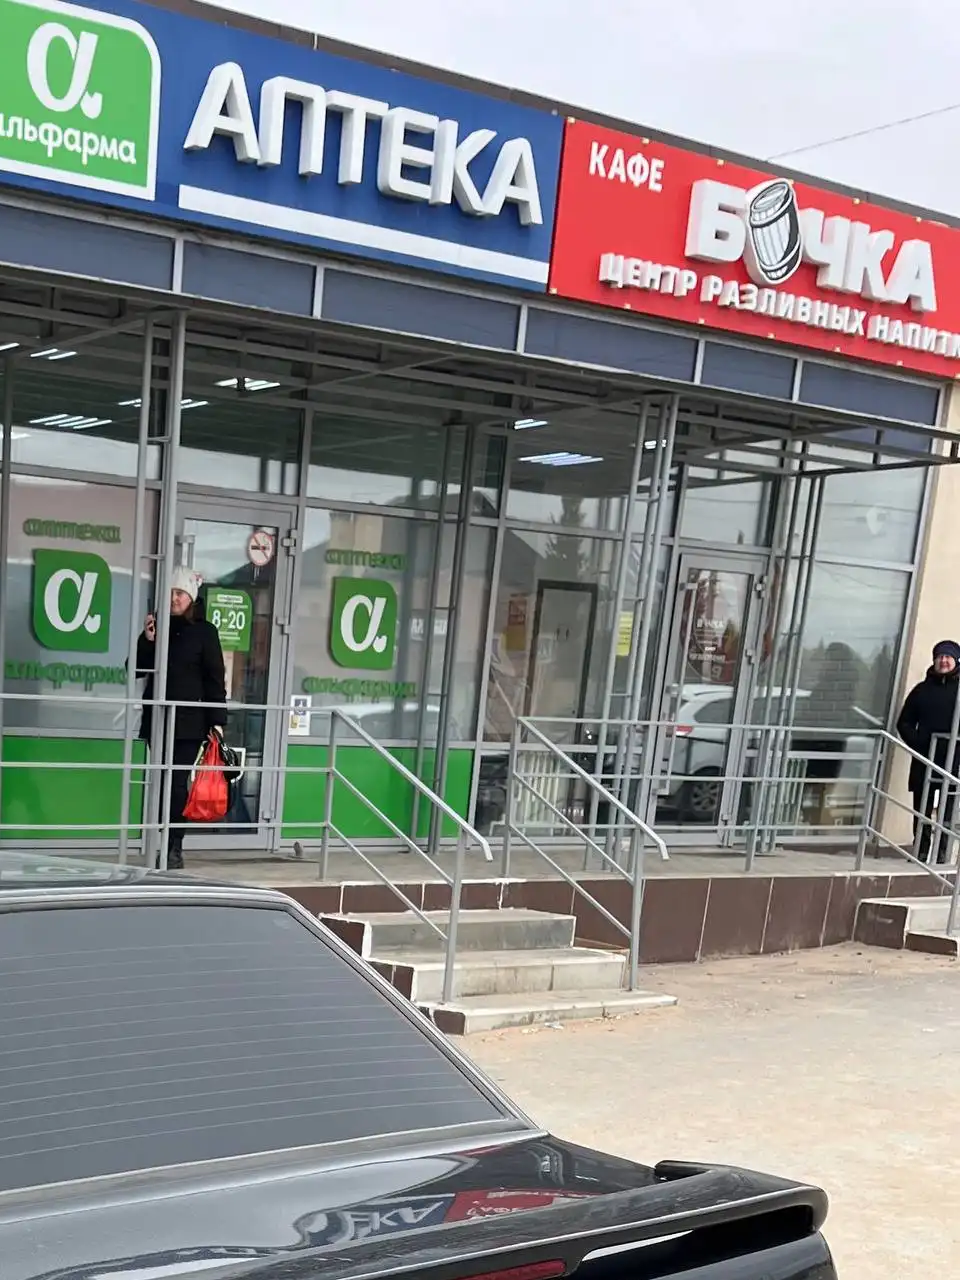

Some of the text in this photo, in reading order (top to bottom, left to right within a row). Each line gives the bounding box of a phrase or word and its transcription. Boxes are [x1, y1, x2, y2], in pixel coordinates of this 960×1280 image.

[184, 62, 543, 225] АПТЕКА
[589, 141, 665, 192] КАФЕ
[599, 252, 697, 297] ЦЕНТР
[700, 275, 867, 336] РАЗЛИВНЫХ
[211, 608, 246, 630] 8-20
